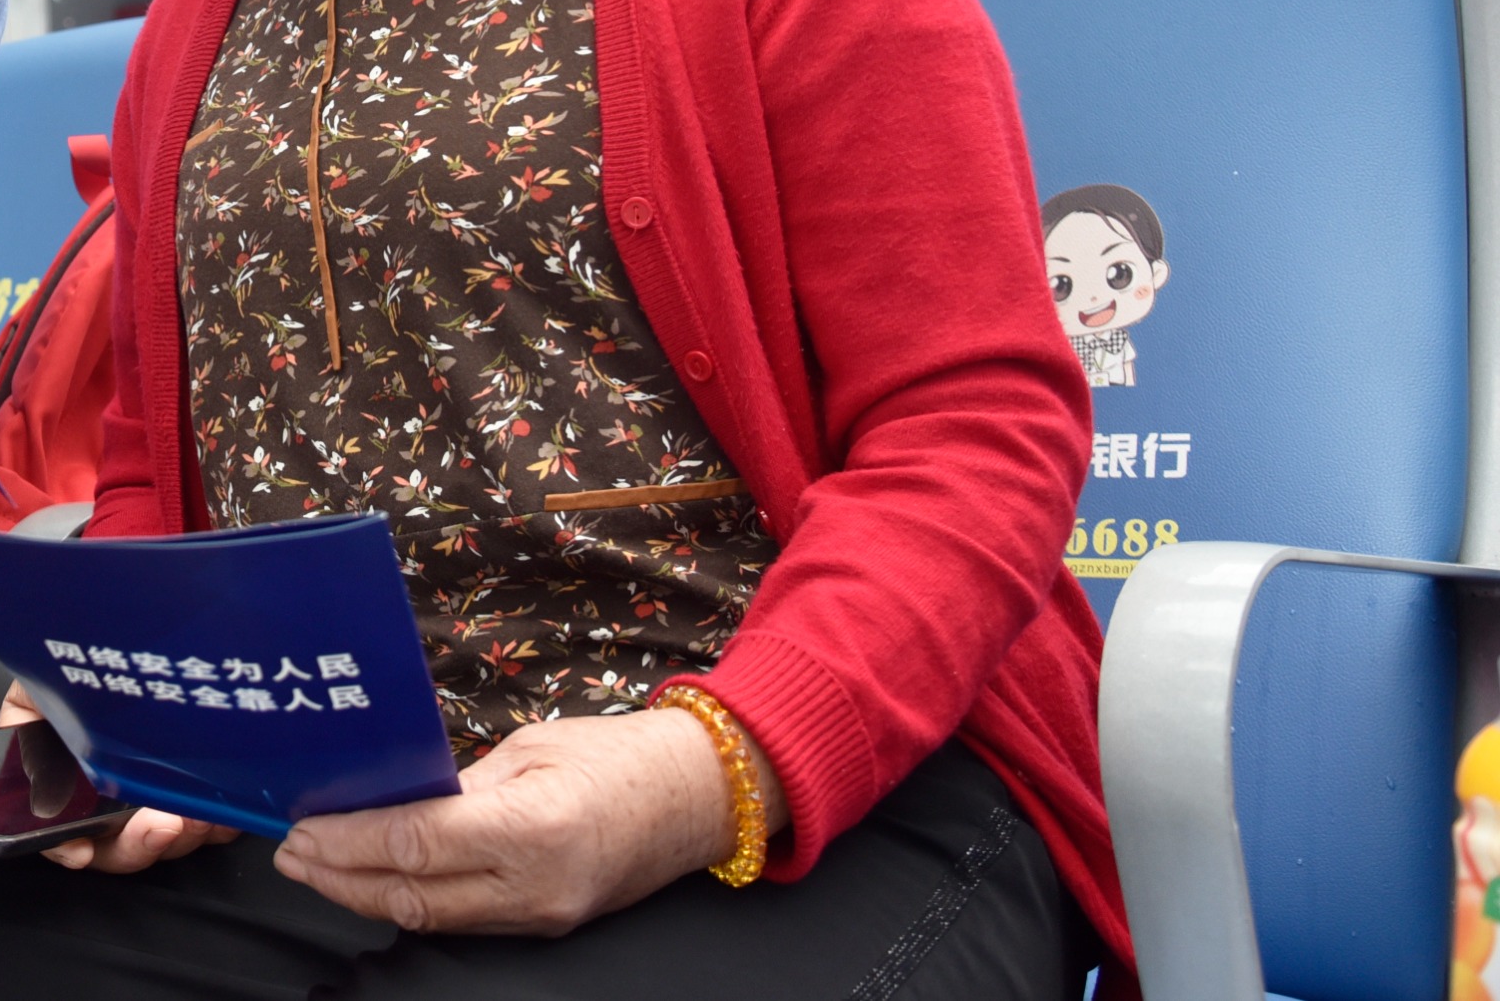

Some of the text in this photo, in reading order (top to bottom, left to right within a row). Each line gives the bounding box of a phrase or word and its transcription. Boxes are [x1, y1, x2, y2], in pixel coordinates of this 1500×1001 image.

[1090, 432, 1192, 479] 银行
[1065, 518, 1180, 557] 6688
[45, 639, 361, 681] 网络安全为人民
[61, 665, 370, 711] 网络安全靠人民
